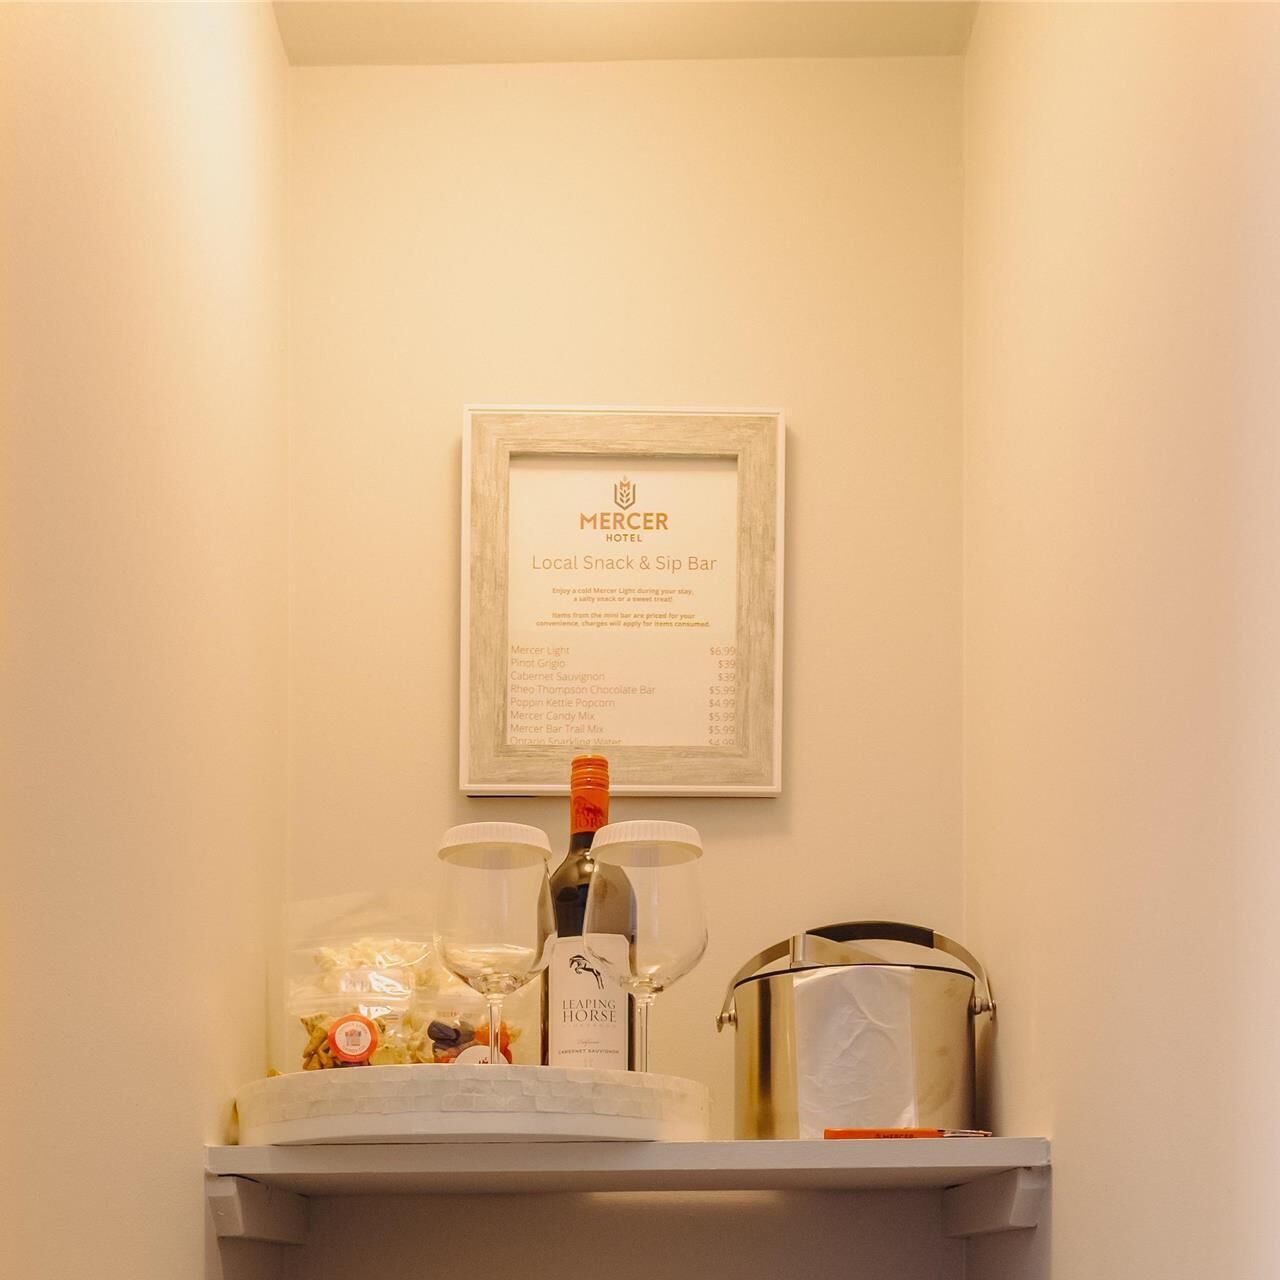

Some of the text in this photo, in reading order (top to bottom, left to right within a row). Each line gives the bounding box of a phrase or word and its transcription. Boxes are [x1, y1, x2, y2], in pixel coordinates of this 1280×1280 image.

[580, 512, 668, 530] MERCER
[605, 533, 642, 542] HOTEL
[532, 555, 717, 574] Local Snack & Sip Bar
[619, 588, 635, 596] Light
[511, 646, 736, 656] Mercer Light $6.99
[511, 659, 736, 670] Pinot Grigio $39
[510, 671, 736, 683] Cabernet Sauvignon $39
[510, 685, 735, 696] Rheo Thompson Chocolate Bar $5.99
[576, 698, 616, 708] Popcorn
[709, 699, 735, 708] $4.99
[510, 712, 735, 723] Mercer Candy Mix $5.99
[510, 724, 735, 734] Mercer Bar Trail Mix $5.99
[562, 999, 616, 1009] LEAPING
[563, 1010, 616, 1023] HORSE
